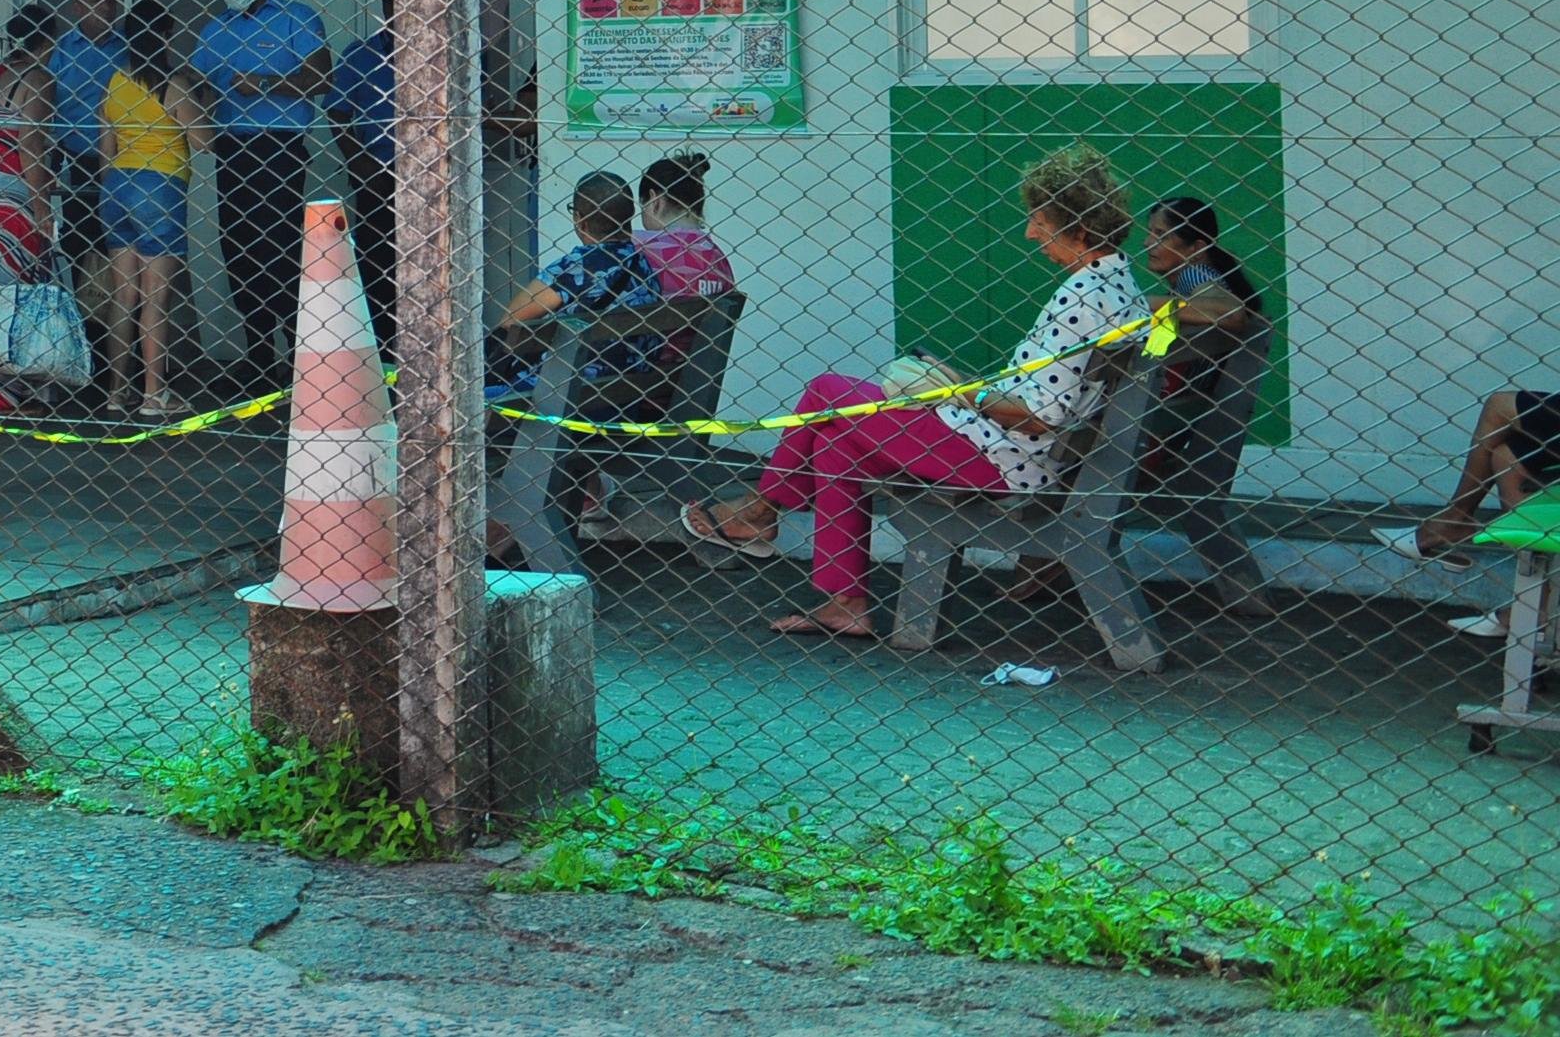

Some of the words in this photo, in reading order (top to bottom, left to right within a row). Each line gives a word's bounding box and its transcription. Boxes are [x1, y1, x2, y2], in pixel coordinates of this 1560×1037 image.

[584, 27, 644, 37] ATENDIMENTO
[639, 36, 657, 45] DAS
[698, 279, 723, 295] RITA
